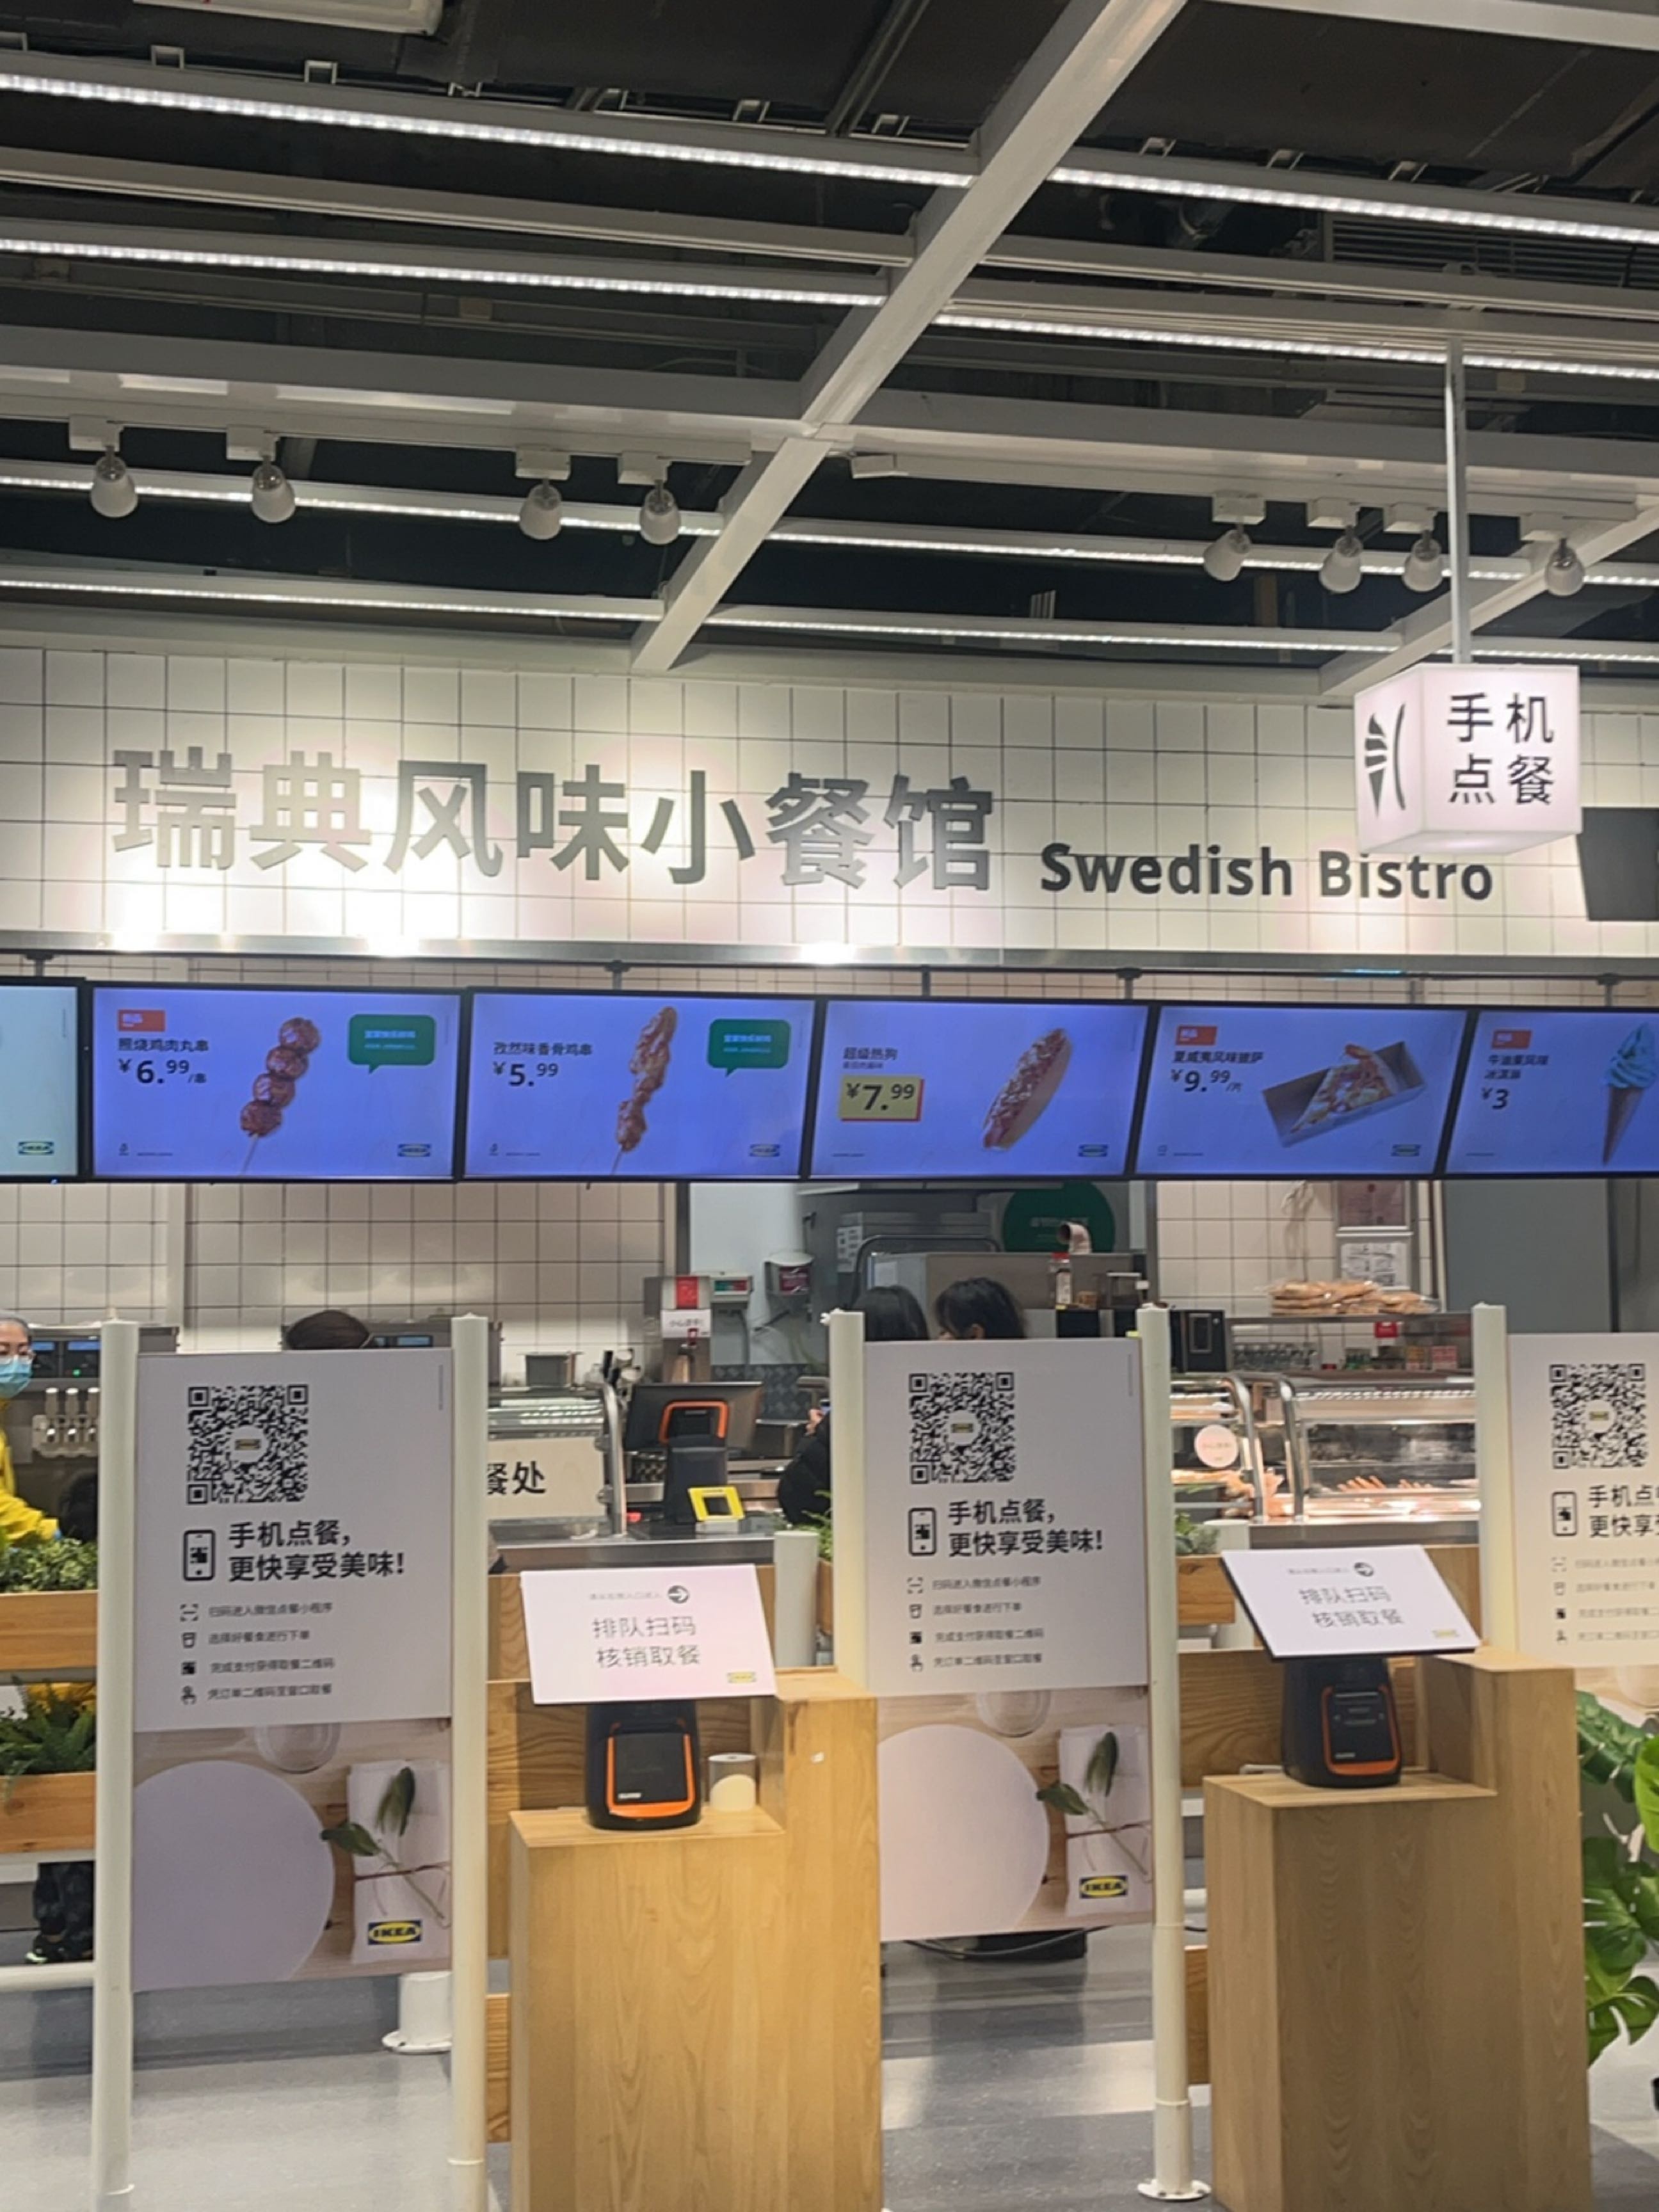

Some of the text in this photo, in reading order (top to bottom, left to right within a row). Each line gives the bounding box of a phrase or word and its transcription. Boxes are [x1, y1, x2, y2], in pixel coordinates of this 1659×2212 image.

[1447, 692, 1555, 744] 手机
[1447, 754, 1555, 807] 点餐
[111, 745, 993, 891] 瑞典风味小餐馆
[1040, 842, 1493, 902] Swedish Bistro
[492, 1061, 559, 1087] ¥5.99
[846, 1082, 916, 1111] ¥7.99
[1481, 1087, 1510, 1110] ¥3
[1587, 1484, 1659, 1509] 手机点
[948, 1498, 1055, 1527] 手机点餐,
[228, 1519, 351, 1549] 手机点餐,
[948, 1528, 1103, 1558] 更快享受美味!
[228, 1550, 405, 1583] 更快享受美味!
[591, 1615, 697, 1640] 排队扫码
[597, 1644, 701, 1669] 核销取餐
